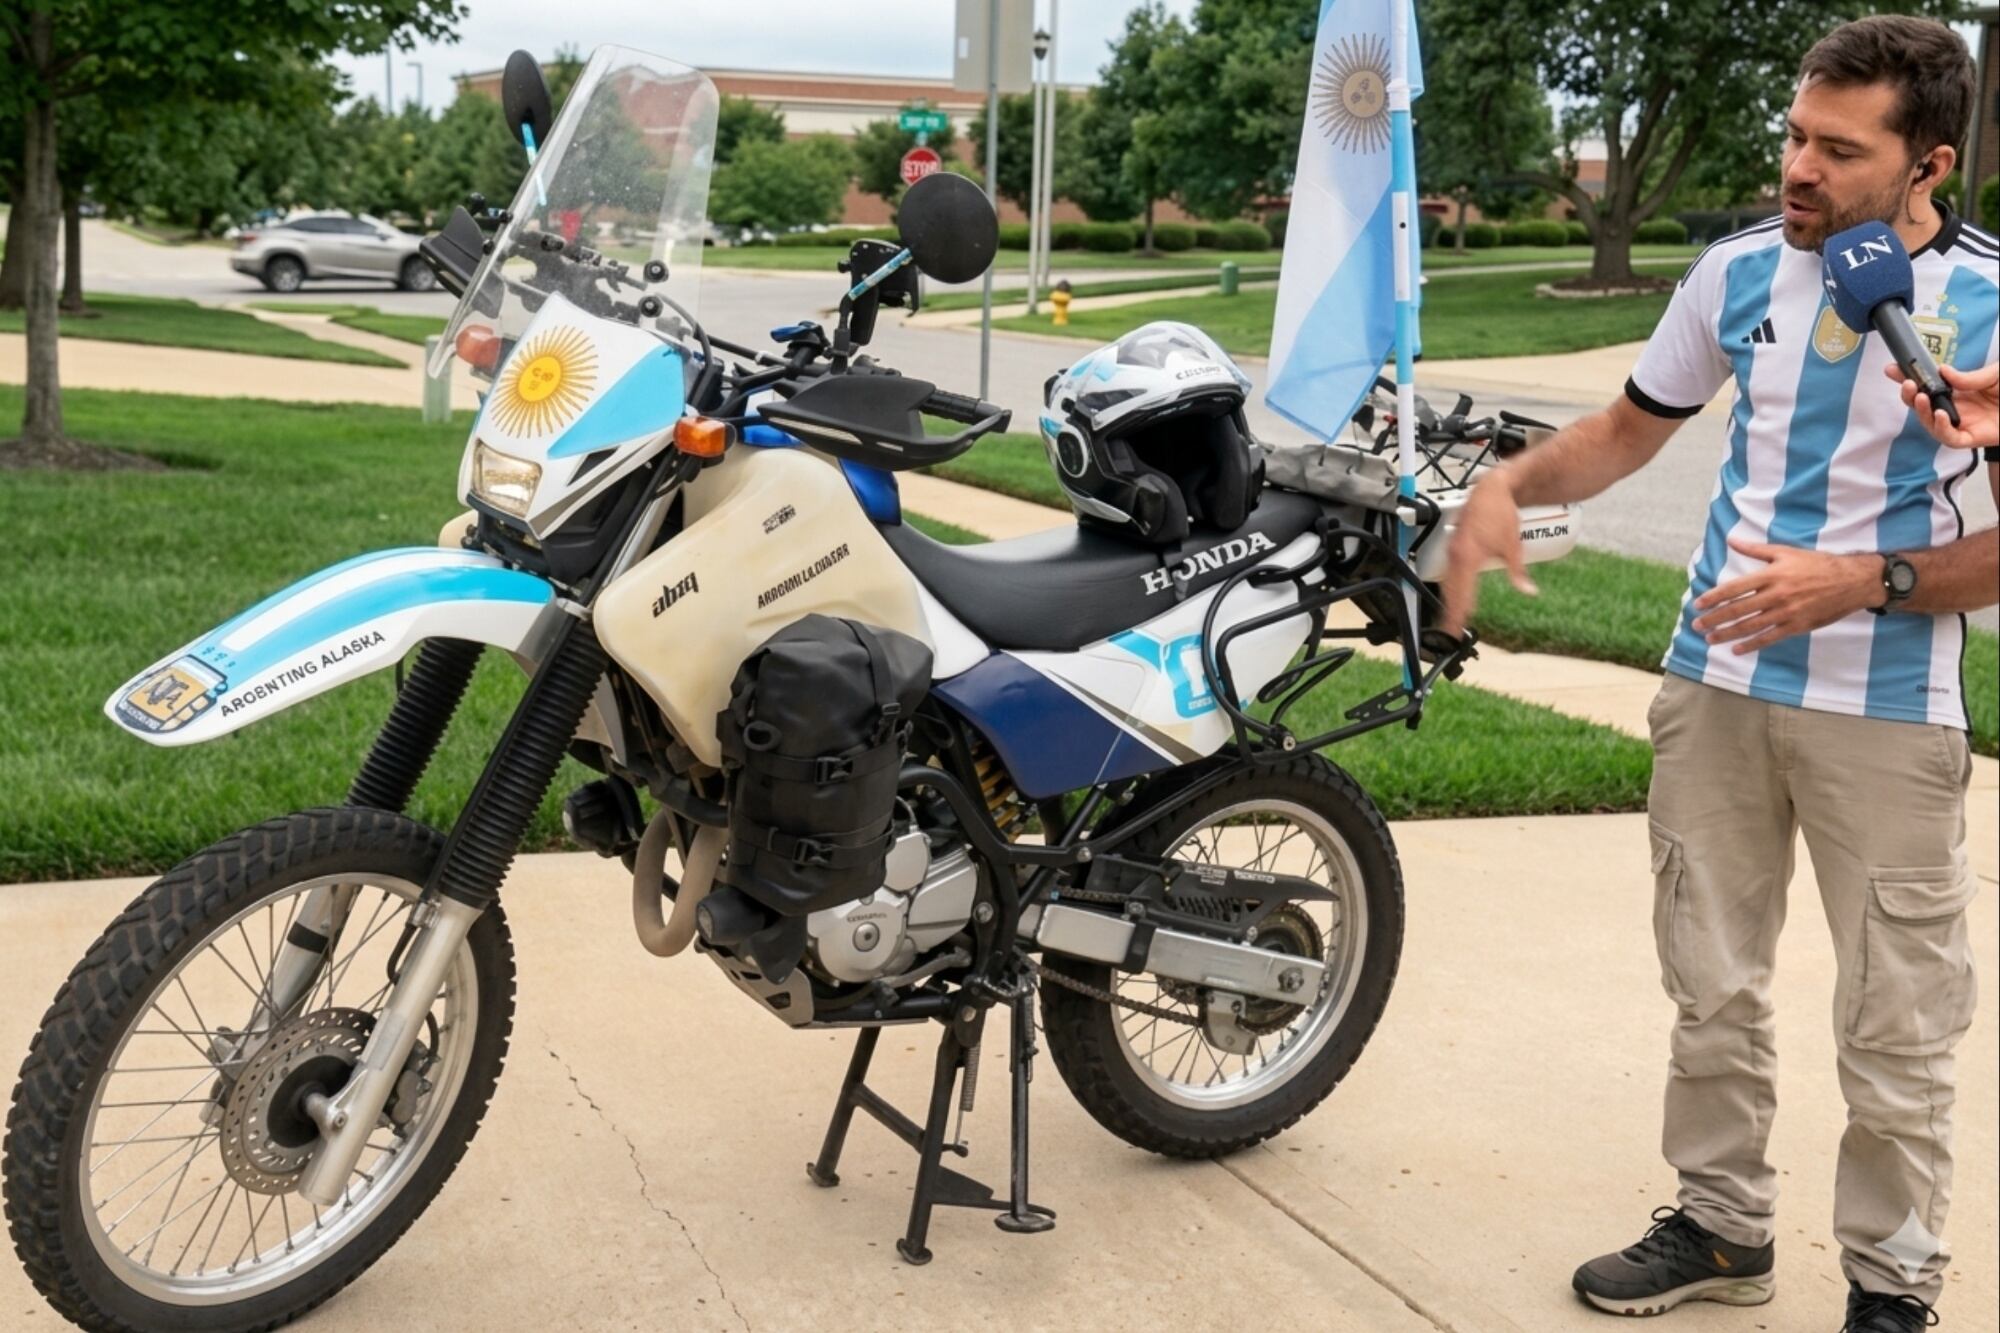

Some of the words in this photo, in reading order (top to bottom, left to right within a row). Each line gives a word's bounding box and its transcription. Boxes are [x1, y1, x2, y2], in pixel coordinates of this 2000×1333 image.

[903, 160, 938, 177] STOP
[1839, 234, 1893, 271] LN
[1140, 531, 1277, 595] HONDA
[320, 631, 386, 669] ALASKA
